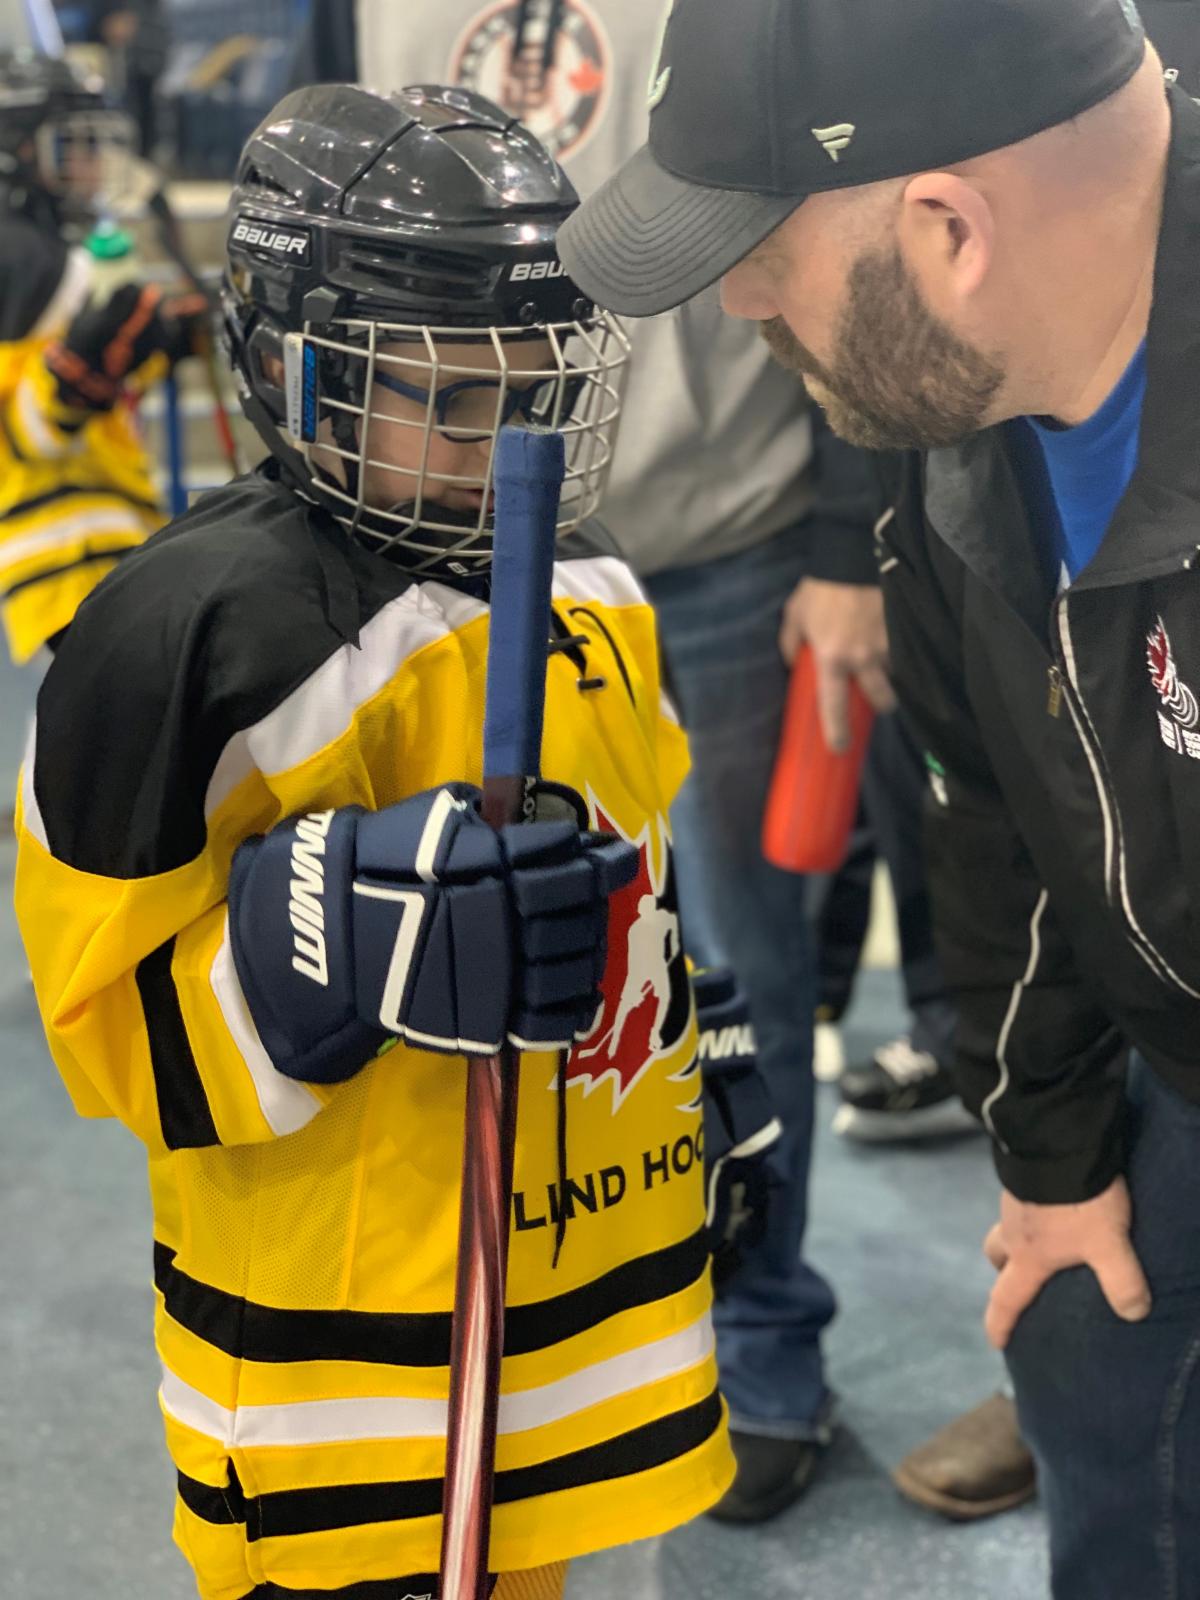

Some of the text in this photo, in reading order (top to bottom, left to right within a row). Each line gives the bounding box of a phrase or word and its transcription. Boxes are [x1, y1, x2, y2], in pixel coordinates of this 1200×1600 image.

[233, 224, 307, 254] BAUER
[509, 261, 568, 281] BAU
[513, 1165, 626, 1232] LIND
